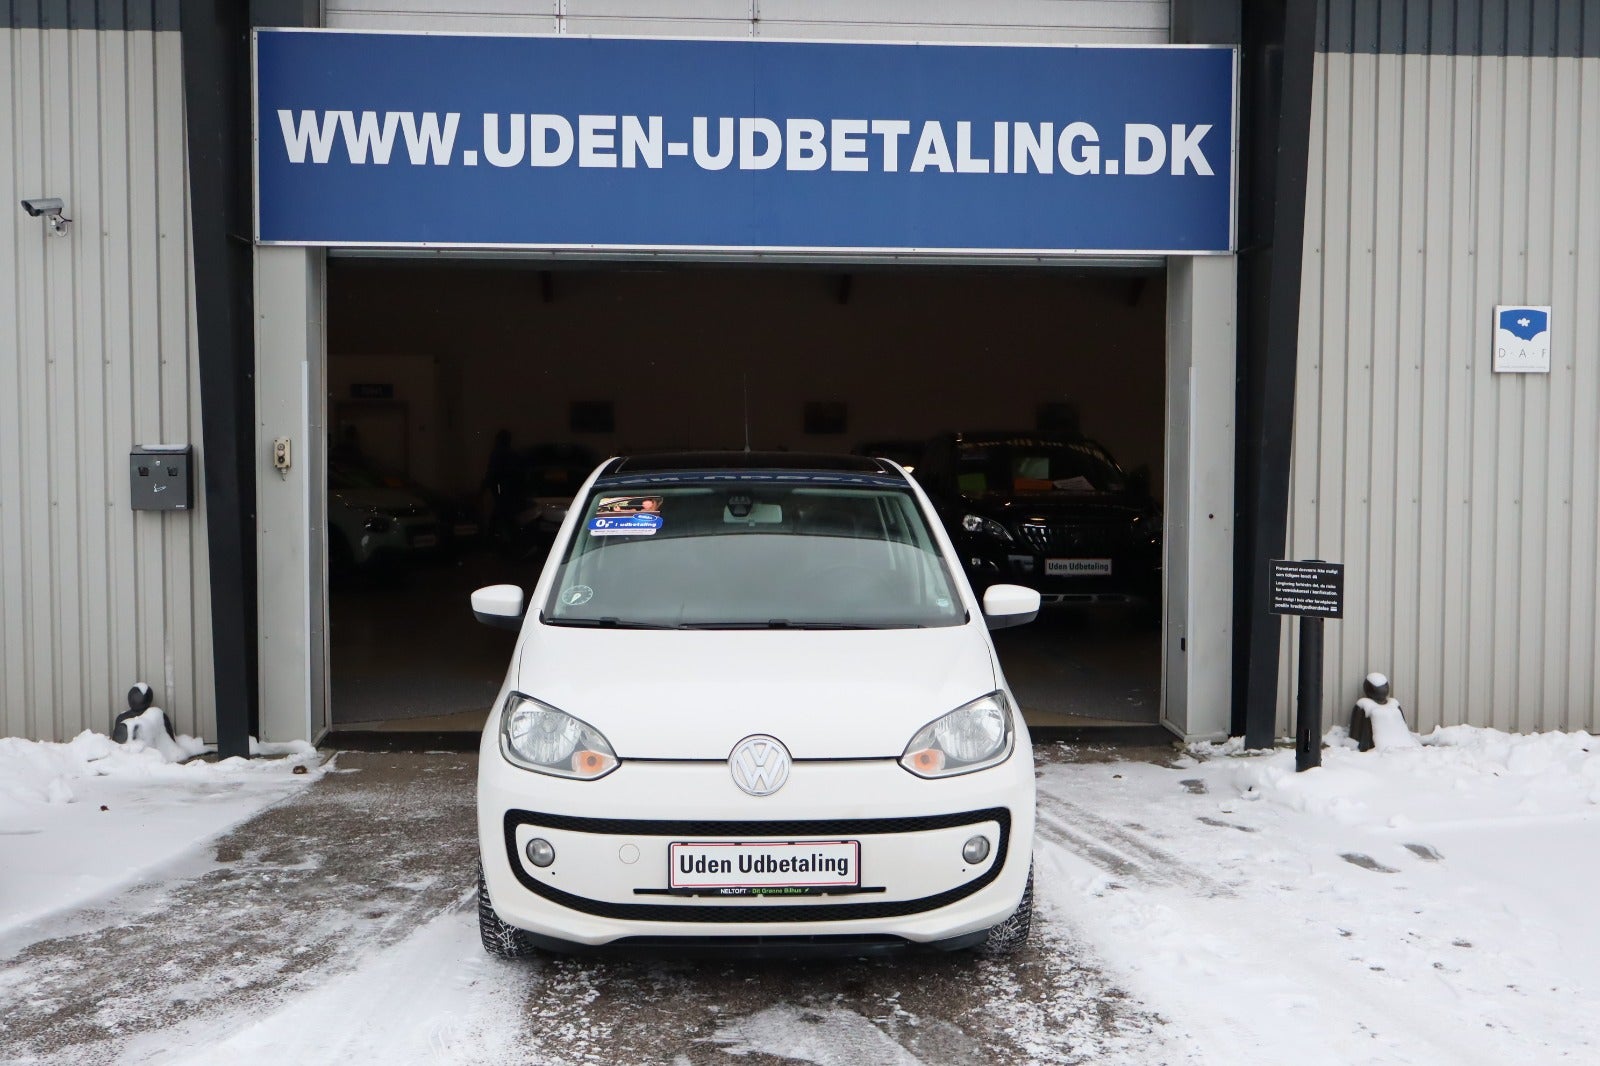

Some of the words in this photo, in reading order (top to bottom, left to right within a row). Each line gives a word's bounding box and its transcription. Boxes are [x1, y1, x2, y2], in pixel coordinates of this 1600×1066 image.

[277, 109, 1215, 177] WWW.UDEN-UDBETALING.DK
[1048, 562, 1068, 570] Uden
[1069, 562, 1109, 571] Udbetaling
[680, 854, 732, 874] Uden
[738, 853, 849, 876] Udbetaling
